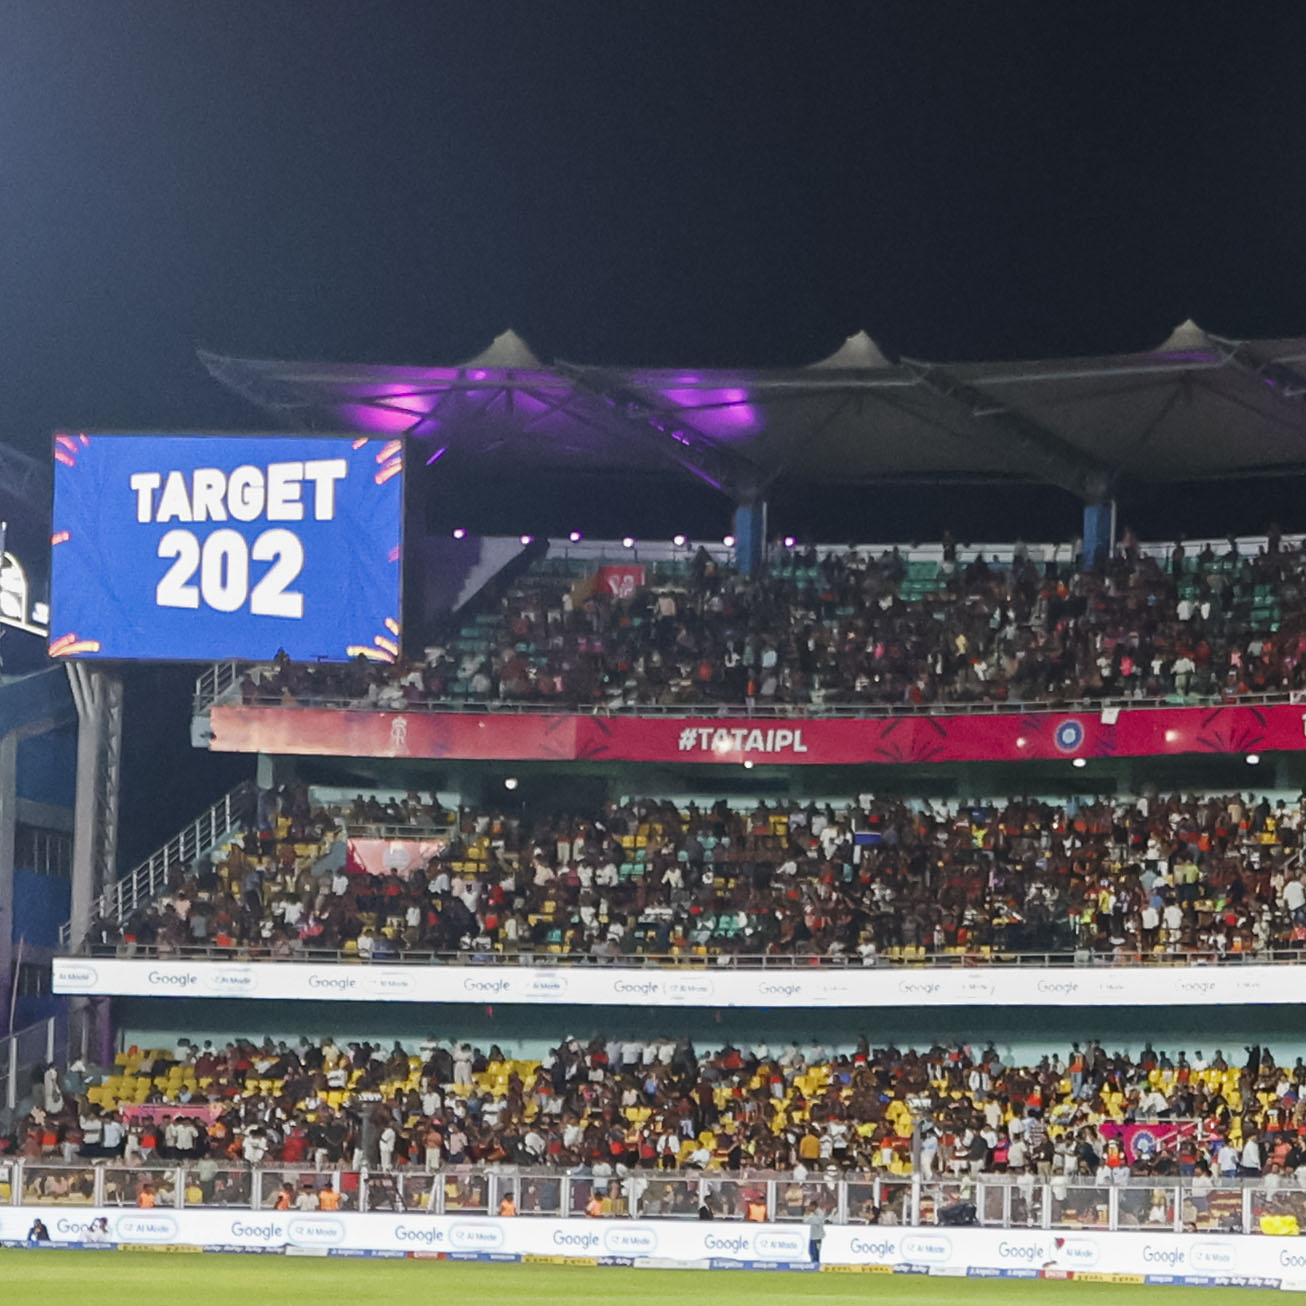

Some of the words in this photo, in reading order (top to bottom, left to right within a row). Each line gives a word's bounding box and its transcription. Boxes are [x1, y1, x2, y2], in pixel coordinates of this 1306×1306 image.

[130, 458, 348, 523] TARGET
[156, 528, 304, 619] 202
[678, 727, 808, 752] #TATAIPL
[148, 971, 197, 988] Google
[308, 975, 356, 991] Google
[463, 978, 511, 993] Google
[613, 980, 659, 995] Google
[147, 1223, 169, 1233] Mode
[232, 1222, 282, 1240] Google
[396, 1226, 443, 1244] Google
[553, 1230, 599, 1249] Google
[705, 1234, 749, 1253] Google
[850, 1238, 895, 1258] Google
[999, 1242, 1043, 1262] Google
[1143, 1246, 1185, 1266] Google
